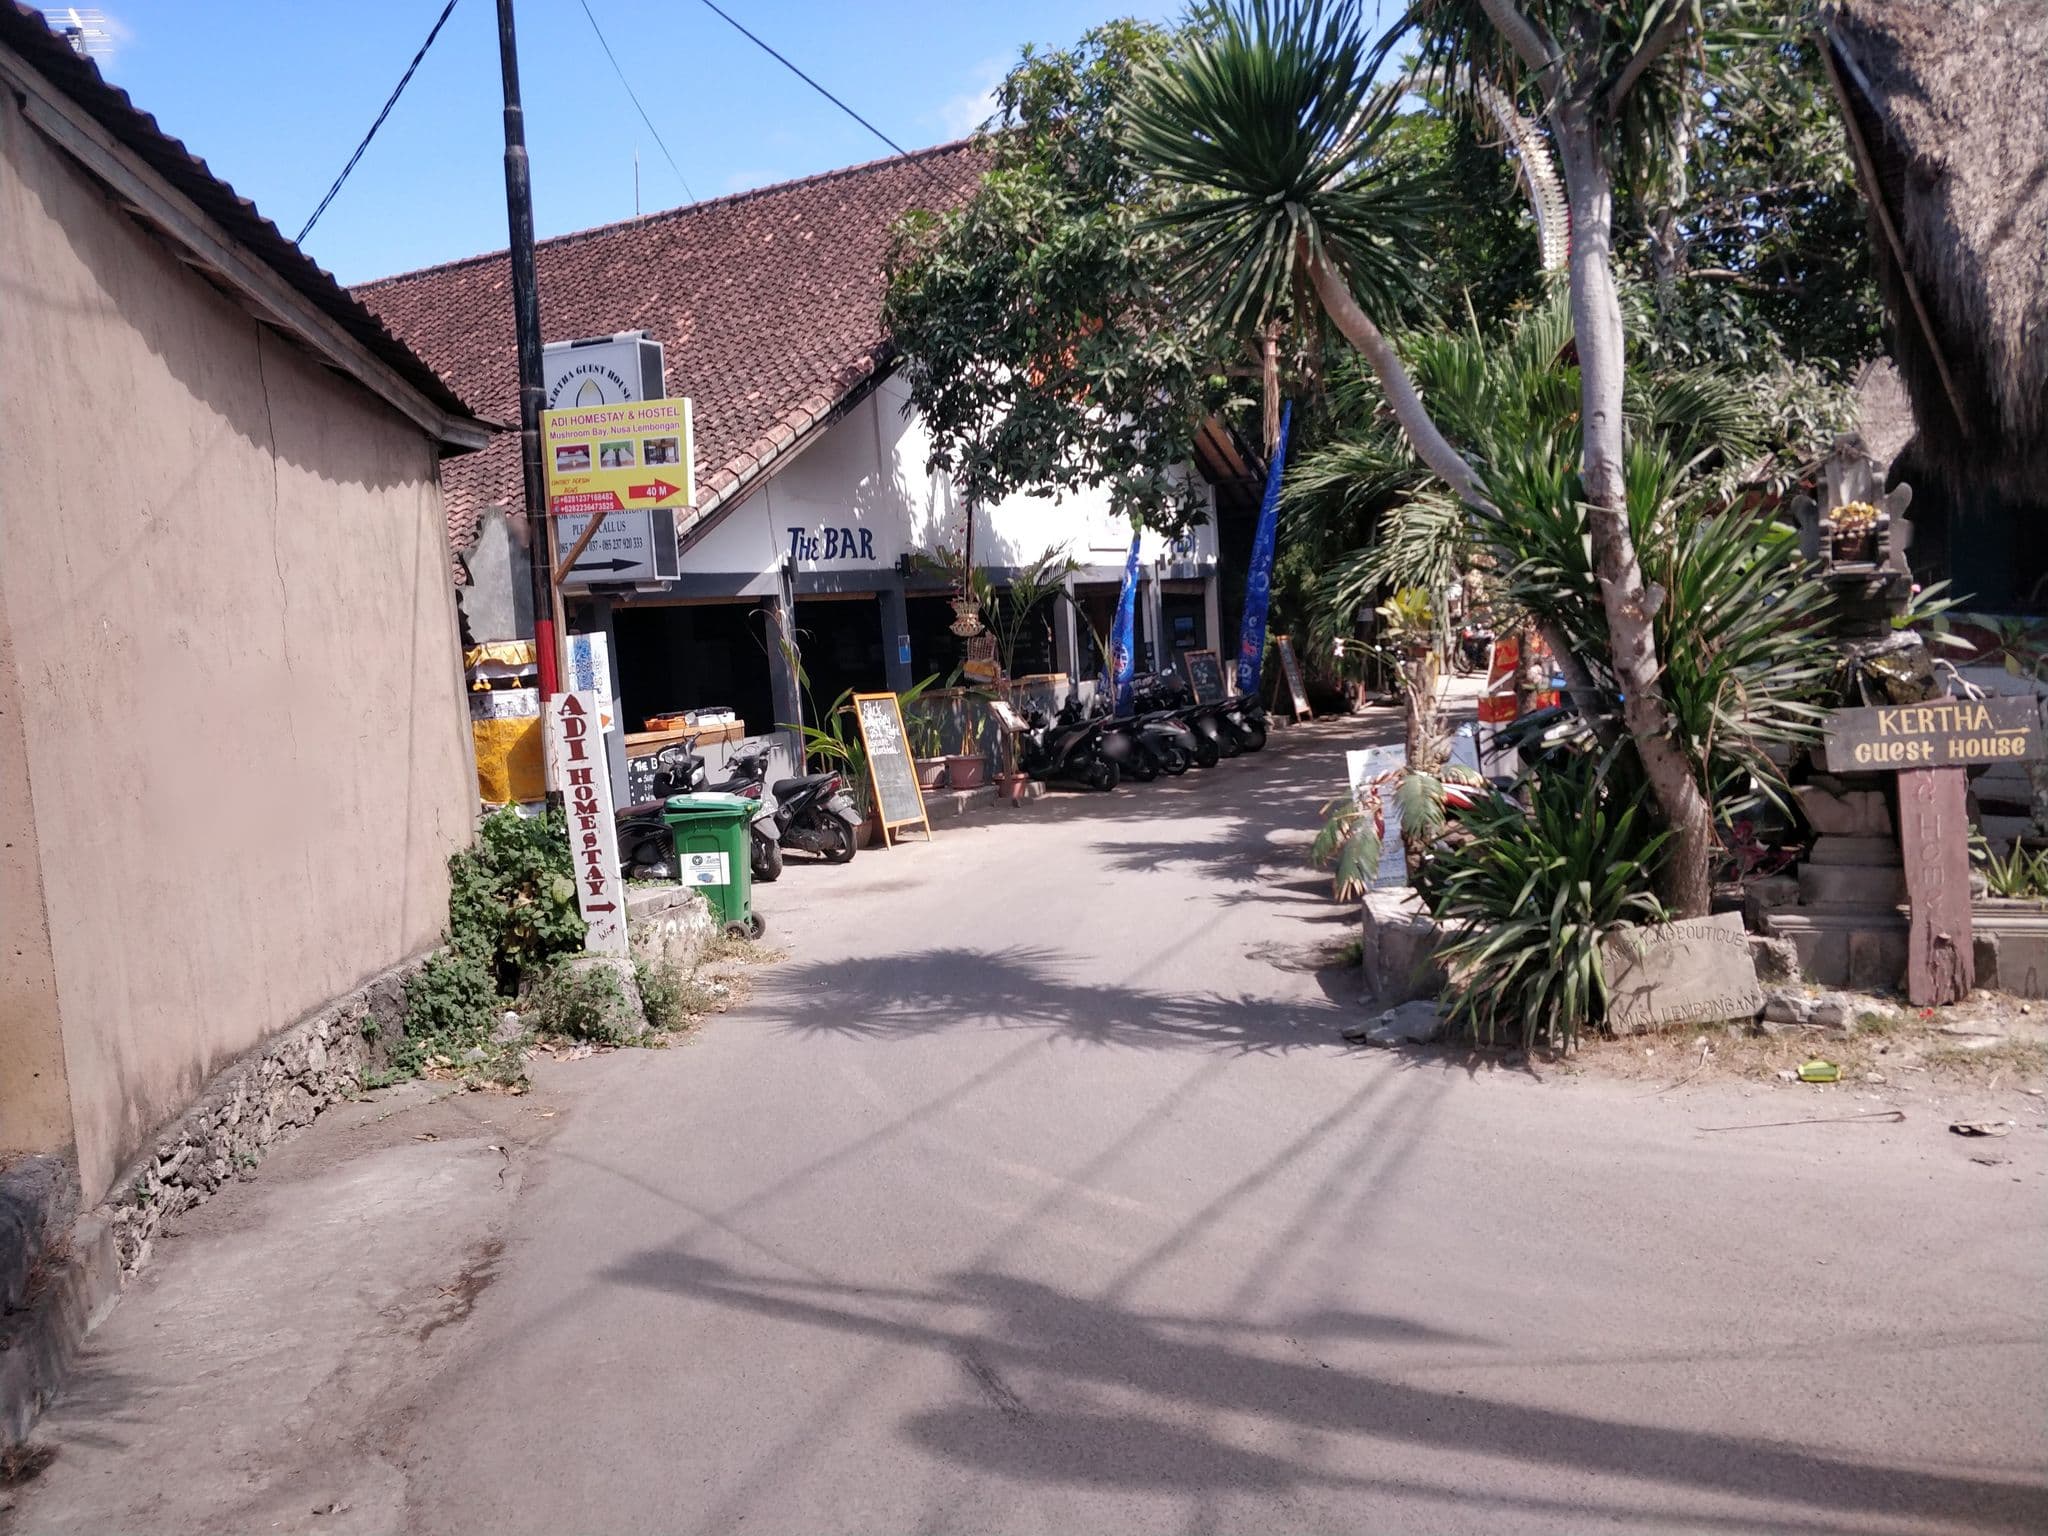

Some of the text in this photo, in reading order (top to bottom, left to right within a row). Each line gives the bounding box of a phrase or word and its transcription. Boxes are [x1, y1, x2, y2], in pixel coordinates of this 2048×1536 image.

[576, 364, 605, 375] GUEST
[607, 370, 632, 402] HOUSE
[550, 428, 591, 440] Mushroom
[611, 425, 631, 435] Nusa
[633, 421, 680, 434] Lembongan
[551, 407, 680, 427] ADI HOMESTAY & HOSTEL
[646, 486, 667, 496] 40 M
[617, 520, 626, 532] US
[823, 527, 876, 561] BAR
[557, 693, 589, 762] ADI
[1878, 704, 1994, 736] KERTHA
[566, 767, 605, 896] HOMESTAY
